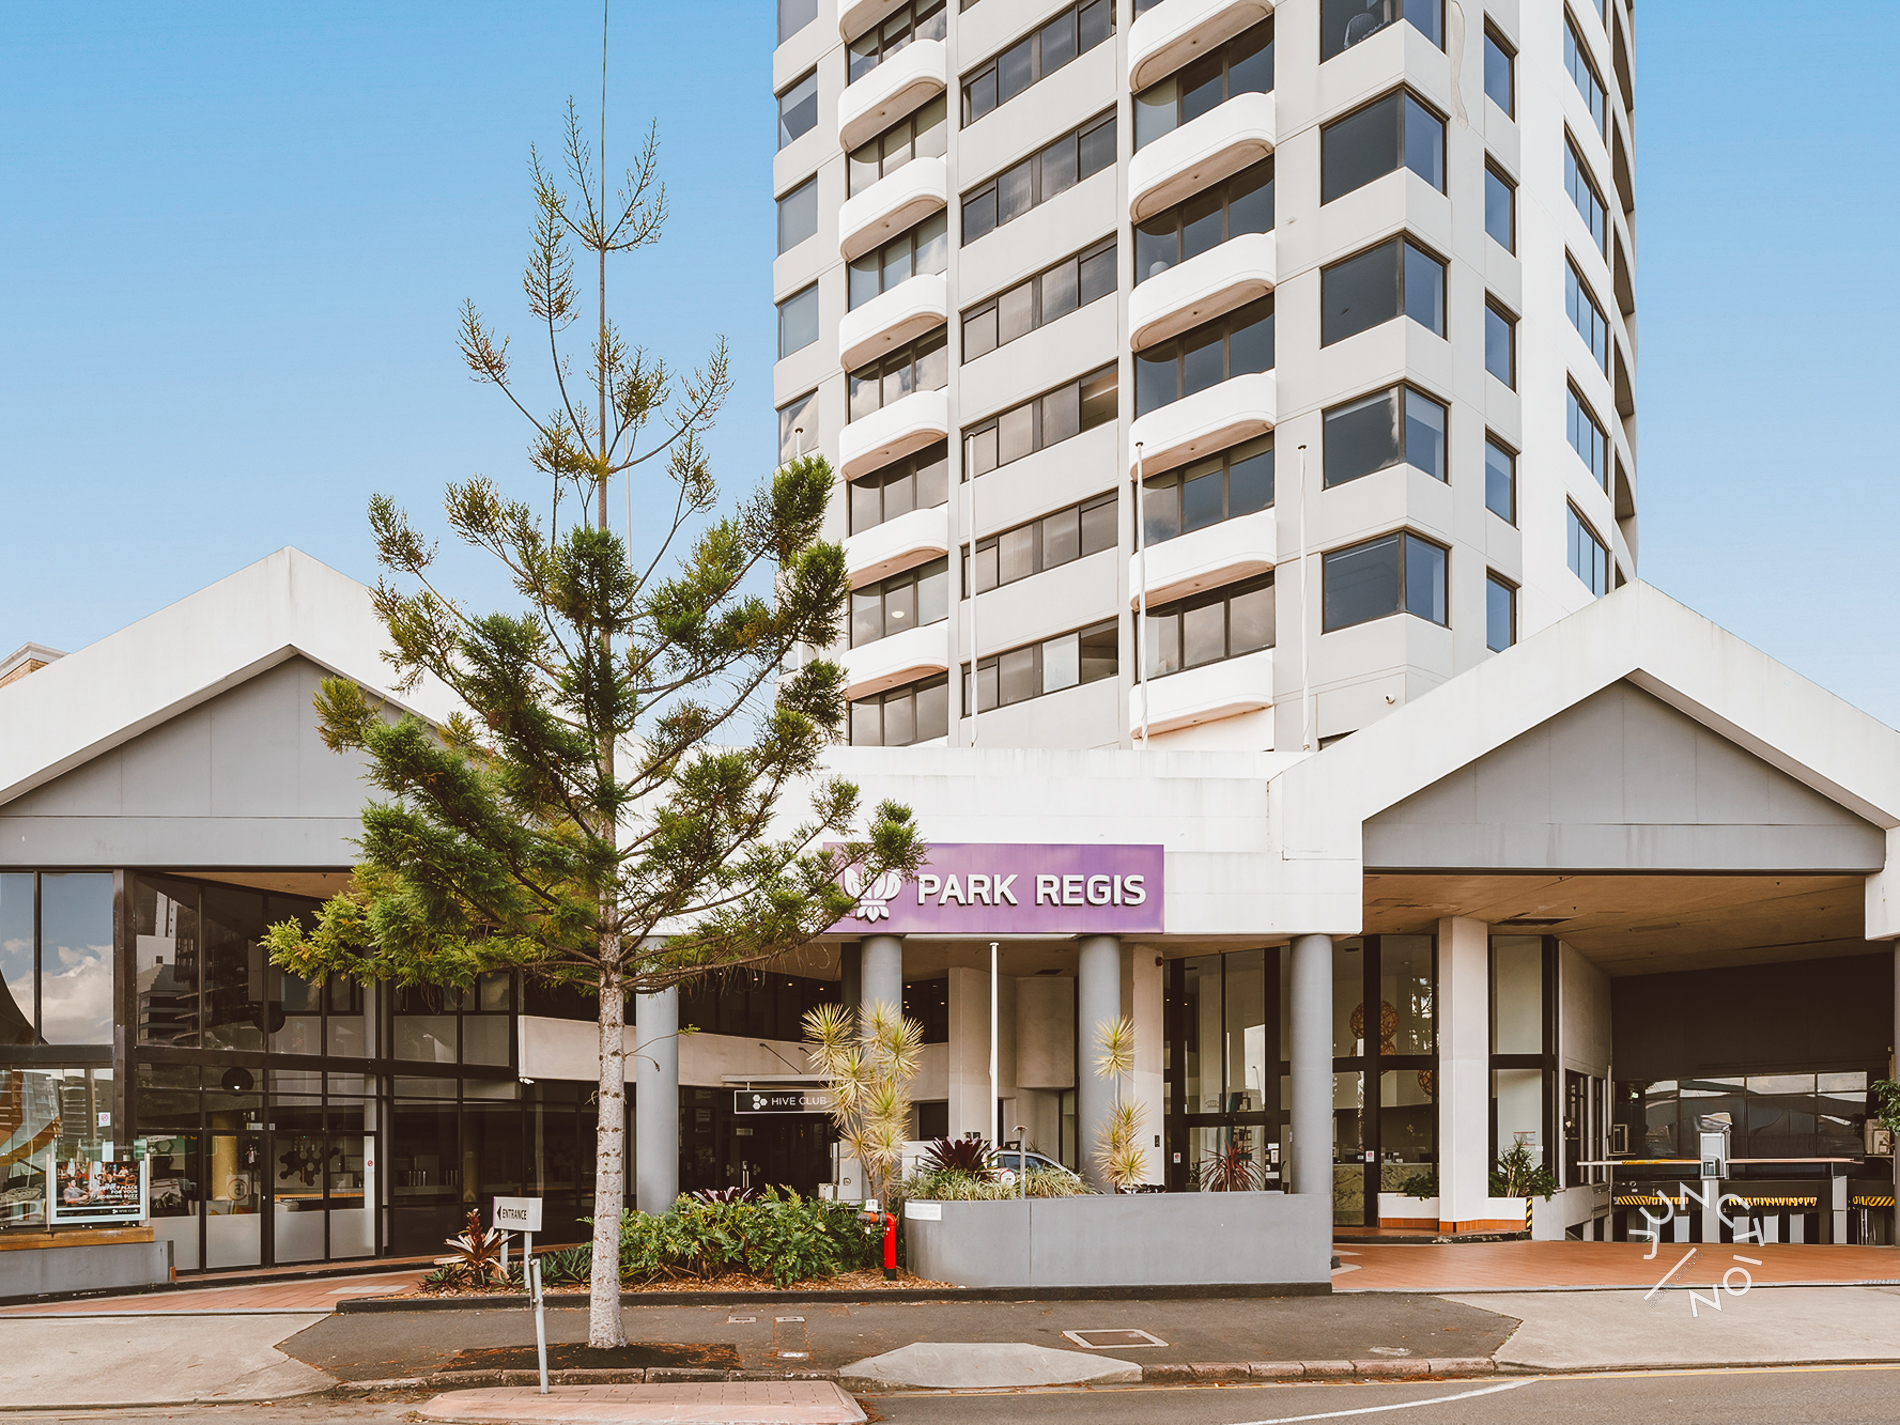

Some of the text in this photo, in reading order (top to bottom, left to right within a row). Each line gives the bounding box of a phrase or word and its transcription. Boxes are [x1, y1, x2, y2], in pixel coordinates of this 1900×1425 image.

[916, 873, 1147, 906] PARK REGIS
[771, 1096, 827, 1106] HIVE CLUB
[502, 1208, 527, 1220] ENTRANCE
